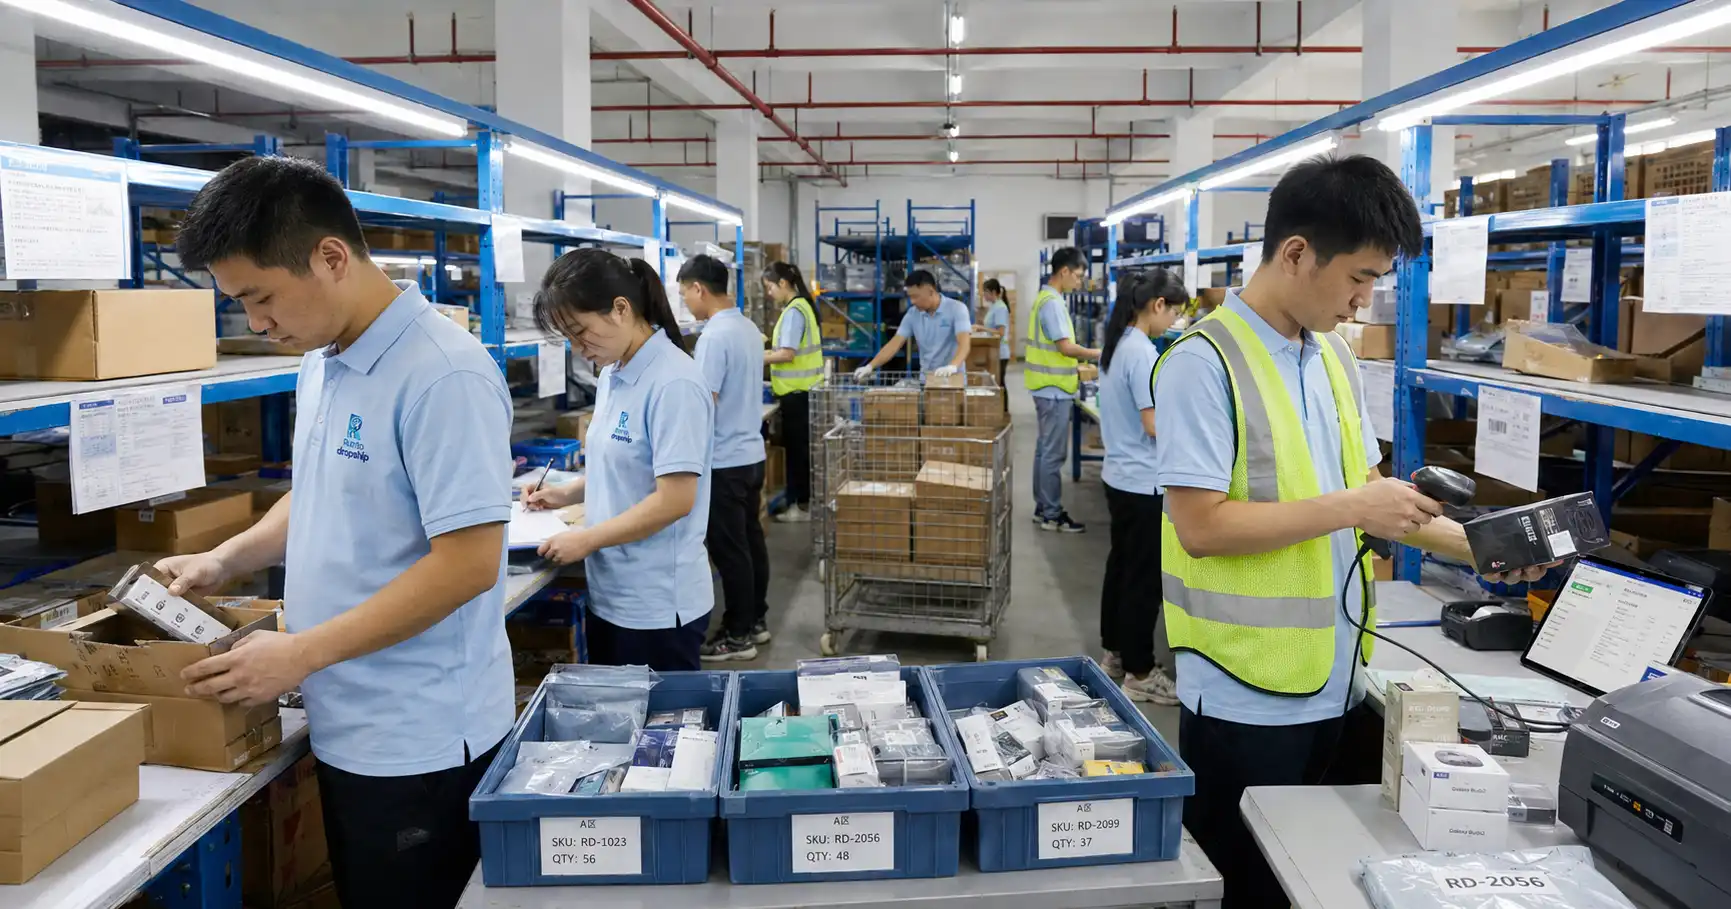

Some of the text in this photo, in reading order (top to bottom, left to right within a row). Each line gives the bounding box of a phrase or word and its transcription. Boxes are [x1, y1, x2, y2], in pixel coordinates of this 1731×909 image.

[336, 446, 370, 463] dropship
[1051, 818, 1120, 833] SKU: RD-2099
[551, 837, 627, 847] SKU: RD-1023
[806, 832, 880, 844] SKU: RD-2056
[1051, 837, 1093, 850] QTY: 37
[552, 853, 596, 864] QTY: 56
[806, 850, 850, 863] QTY: 48
[1444, 875, 1546, 889] RD-2056
